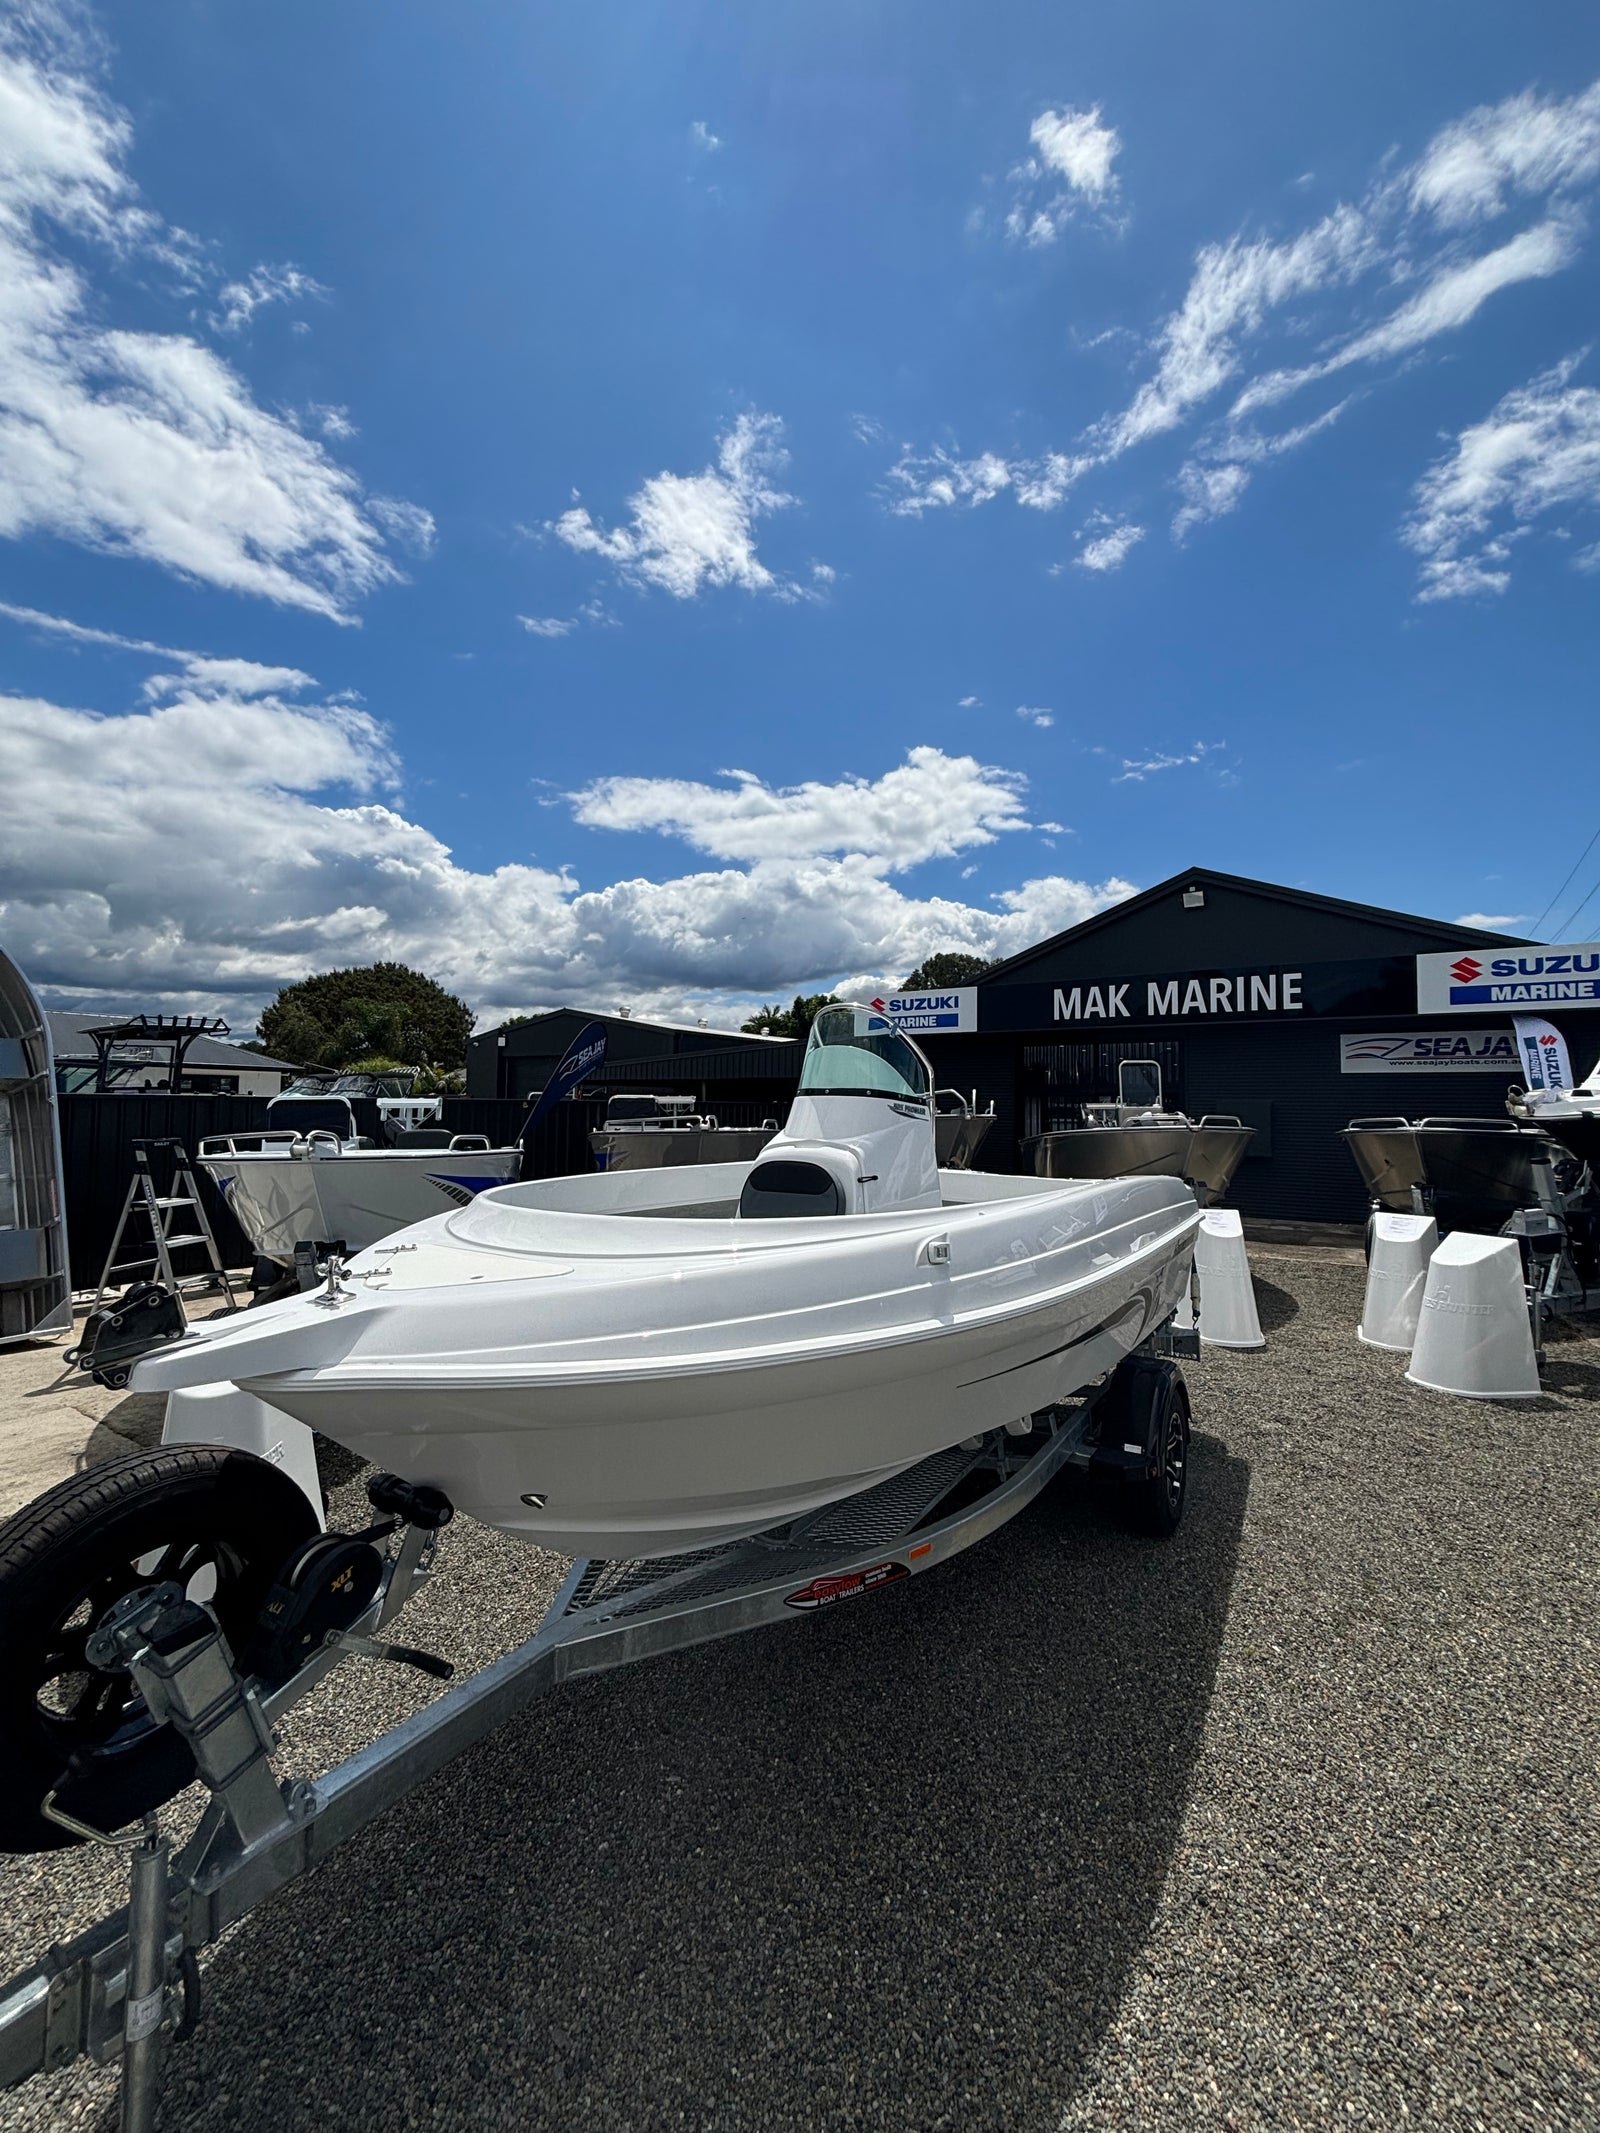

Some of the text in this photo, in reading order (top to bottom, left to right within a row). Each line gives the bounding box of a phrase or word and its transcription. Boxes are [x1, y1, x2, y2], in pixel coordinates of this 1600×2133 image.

[1053, 973, 1303, 1020] MAK MARINE
[1491, 982, 1595, 1001] MARINE
[889, 996, 959, 1011] SUZUKI
[1414, 1037, 1471, 1056] SEA
[331, 1565, 354, 1592] XLT
[820, 1584, 865, 1605] BOAT TRAILERS
